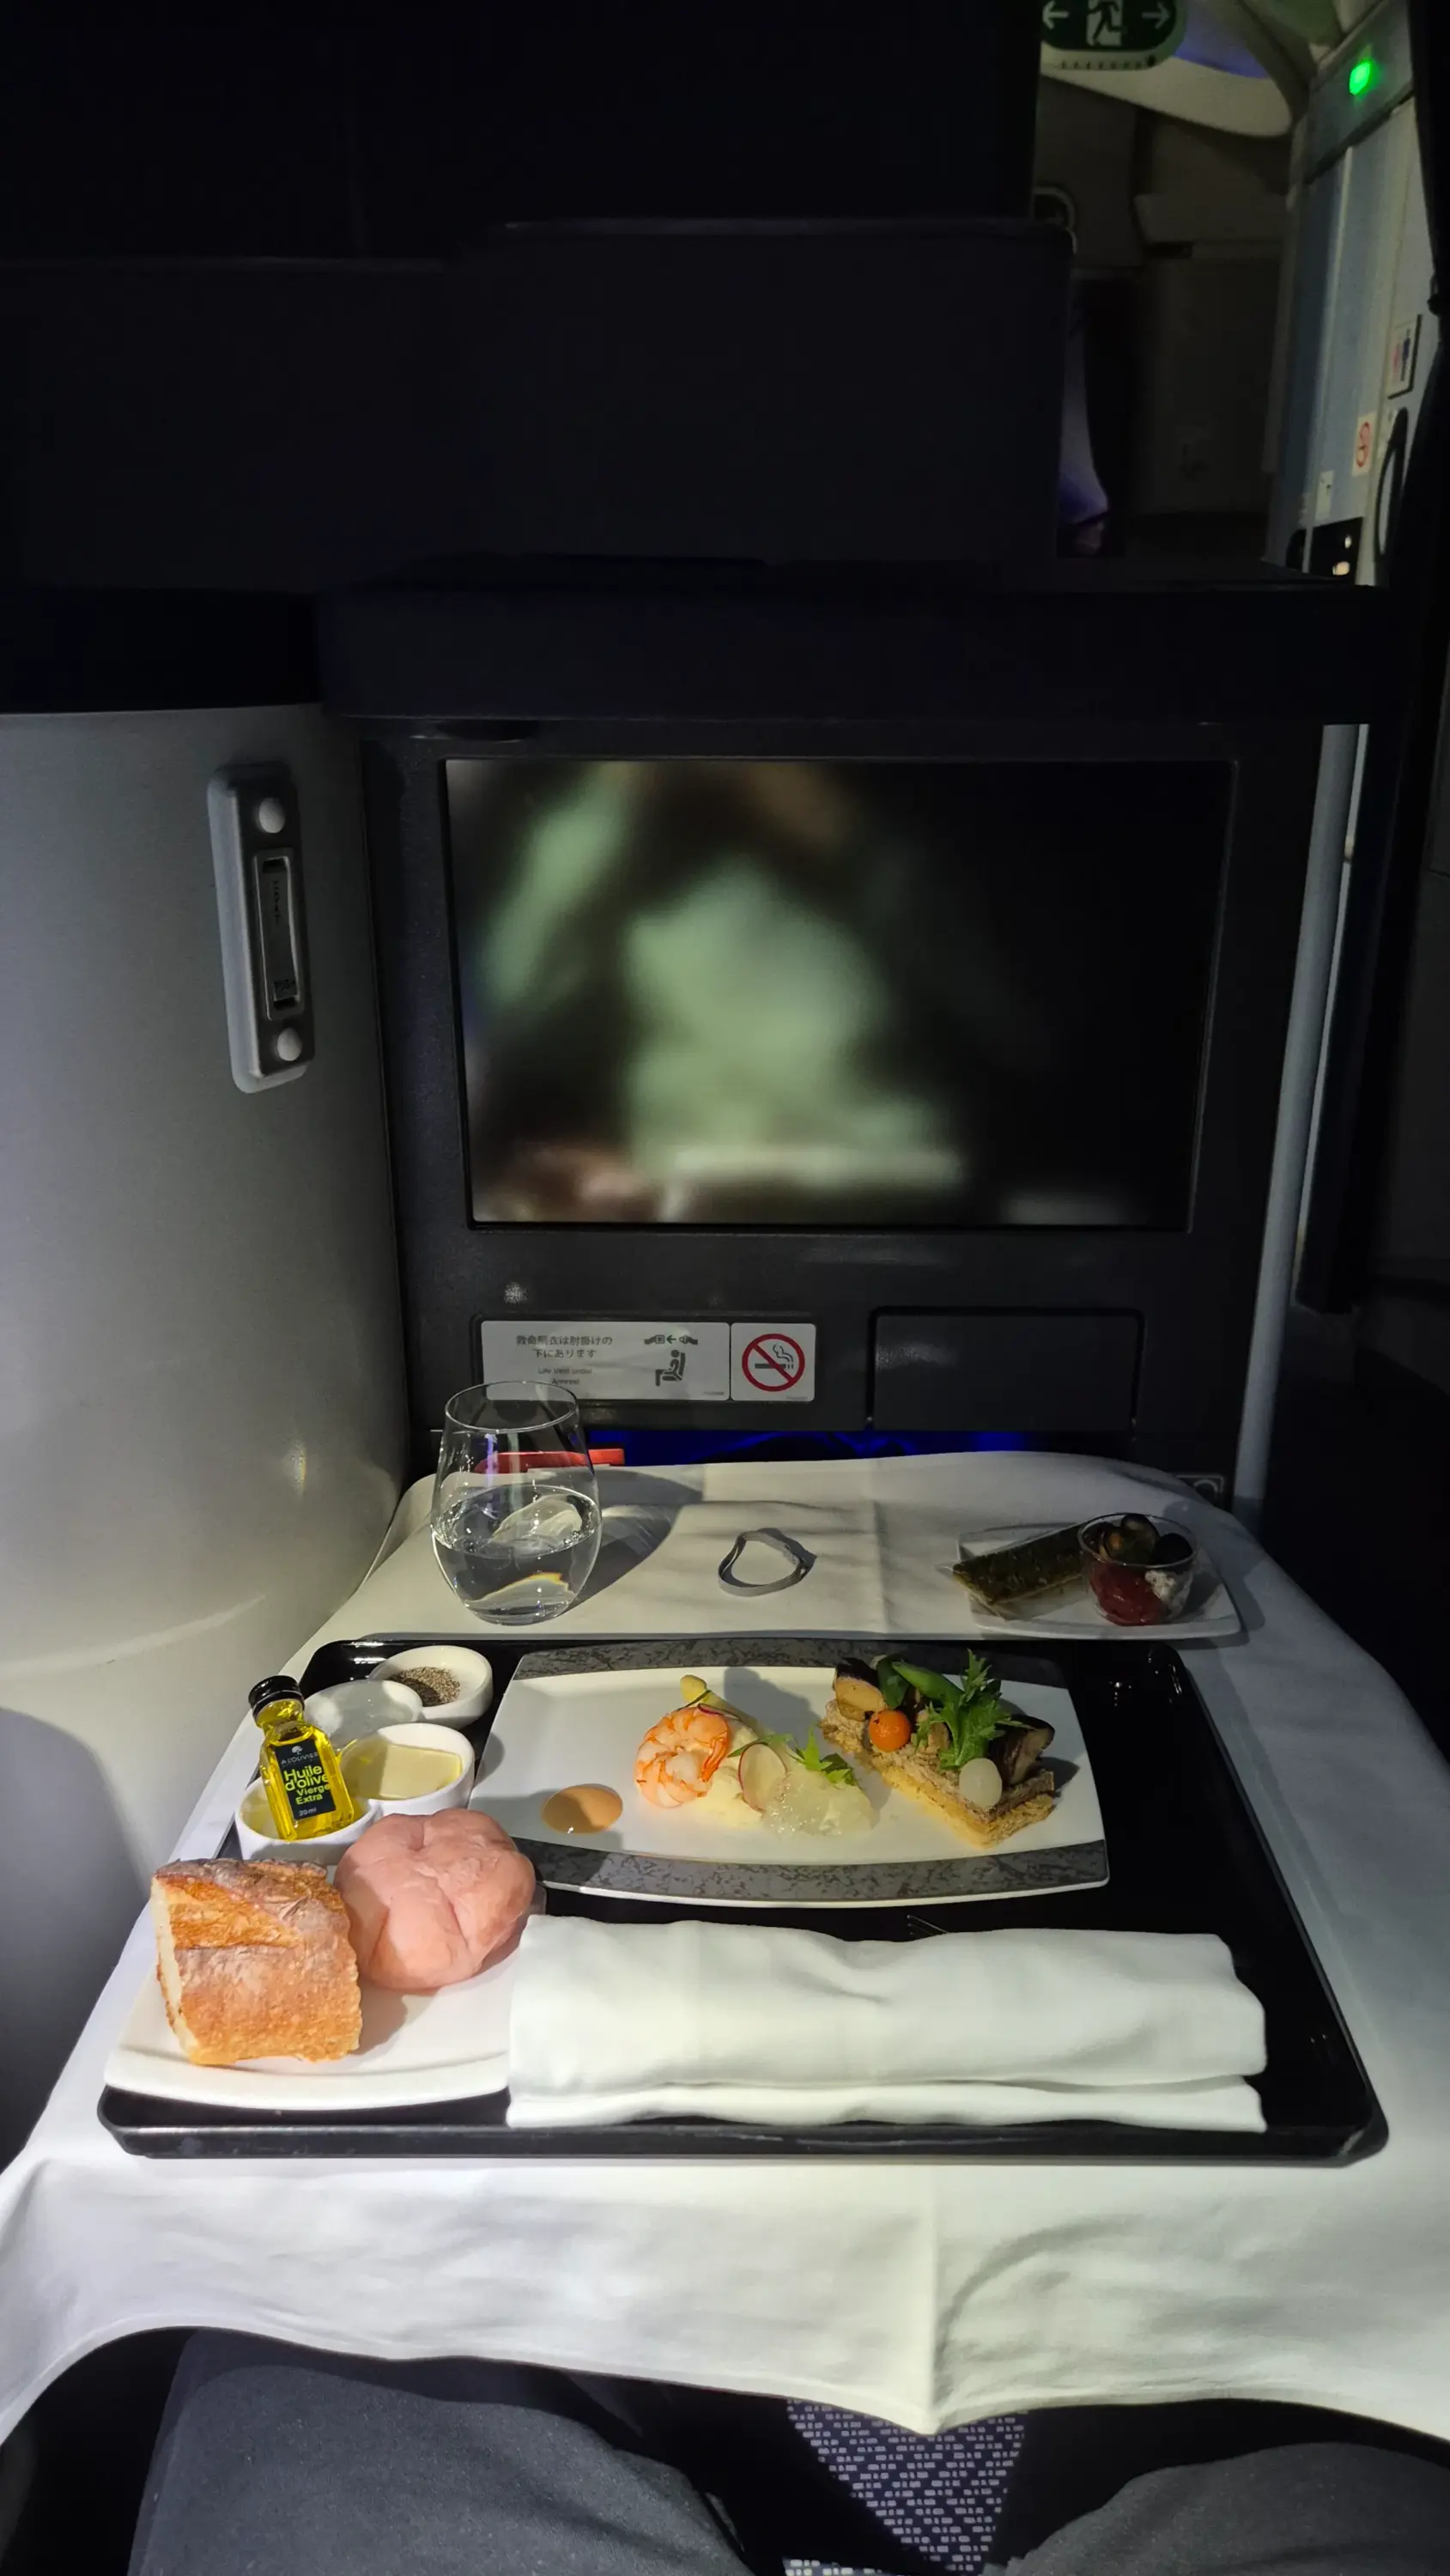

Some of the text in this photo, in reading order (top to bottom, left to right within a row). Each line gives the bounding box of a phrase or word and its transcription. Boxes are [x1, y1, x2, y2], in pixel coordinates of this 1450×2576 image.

[532, 1348, 597, 1358] 下にあります
[283, 1765, 322, 1782] Huile
[296, 1784, 331, 1796] Vierge
[295, 1794, 323, 1806] Extra
